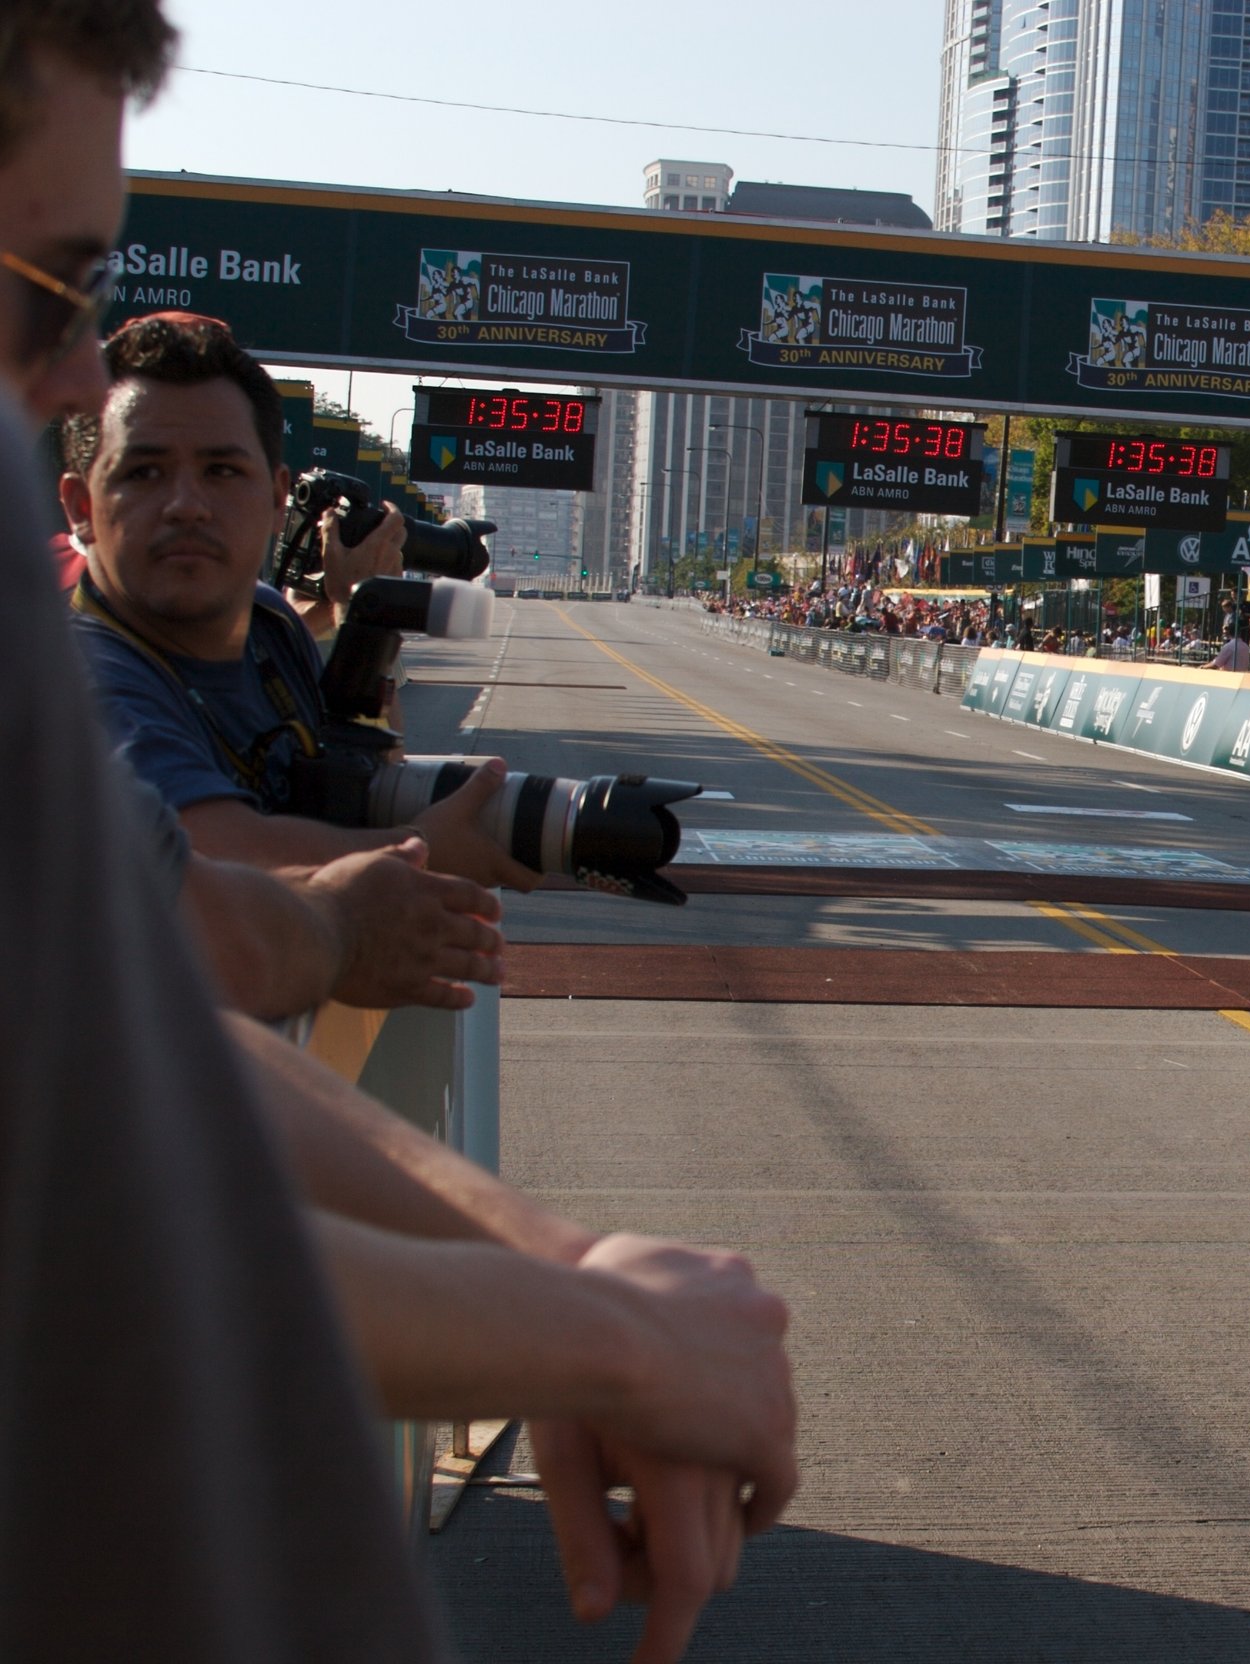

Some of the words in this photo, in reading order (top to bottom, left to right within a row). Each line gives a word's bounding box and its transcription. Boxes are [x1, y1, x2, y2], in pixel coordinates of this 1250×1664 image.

[102, 244, 208, 278] aSalle
[219, 250, 302, 284] Bank
[489, 264, 514, 278] The
[523, 266, 576, 282] LaSalle
[584, 271, 619, 284] Bank
[133, 287, 191, 306] AMRO
[487, 284, 544, 320] Chicago
[550, 288, 617, 320] Marathon
[831, 289, 854, 302] The
[863, 291, 914, 306] LaSalle
[922, 296, 956, 310] Bank
[828, 308, 884, 344] Chicago
[889, 313, 955, 345] Marathon
[1155, 313, 1178, 326] The
[1187, 316, 1236, 331] LaSalle
[437, 325, 470, 339] 30th
[478, 326, 608, 347] ANNIVERSARY
[780, 349, 811, 363] 30th
[819, 350, 945, 371] ANNIVERSARY
[1153, 333, 1207, 368] Chicago
[1107, 372, 1137, 386] 30th
[465, 439, 527, 459] LaSalle
[532, 443, 575, 461] Bank
[463, 461, 485, 472] ABN
[488, 462, 519, 473] AMRO
[853, 462, 919, 484] LaSalle
[924, 468, 969, 488] Bank
[851, 486, 874, 497] ABN
[877, 487, 909, 500] AMRO
[1106, 482, 1165, 501] LaSalle
[1170, 487, 1210, 506] Bank
[1105, 505, 1125, 514] ABN
[1128, 506, 1157, 516] AMRO
